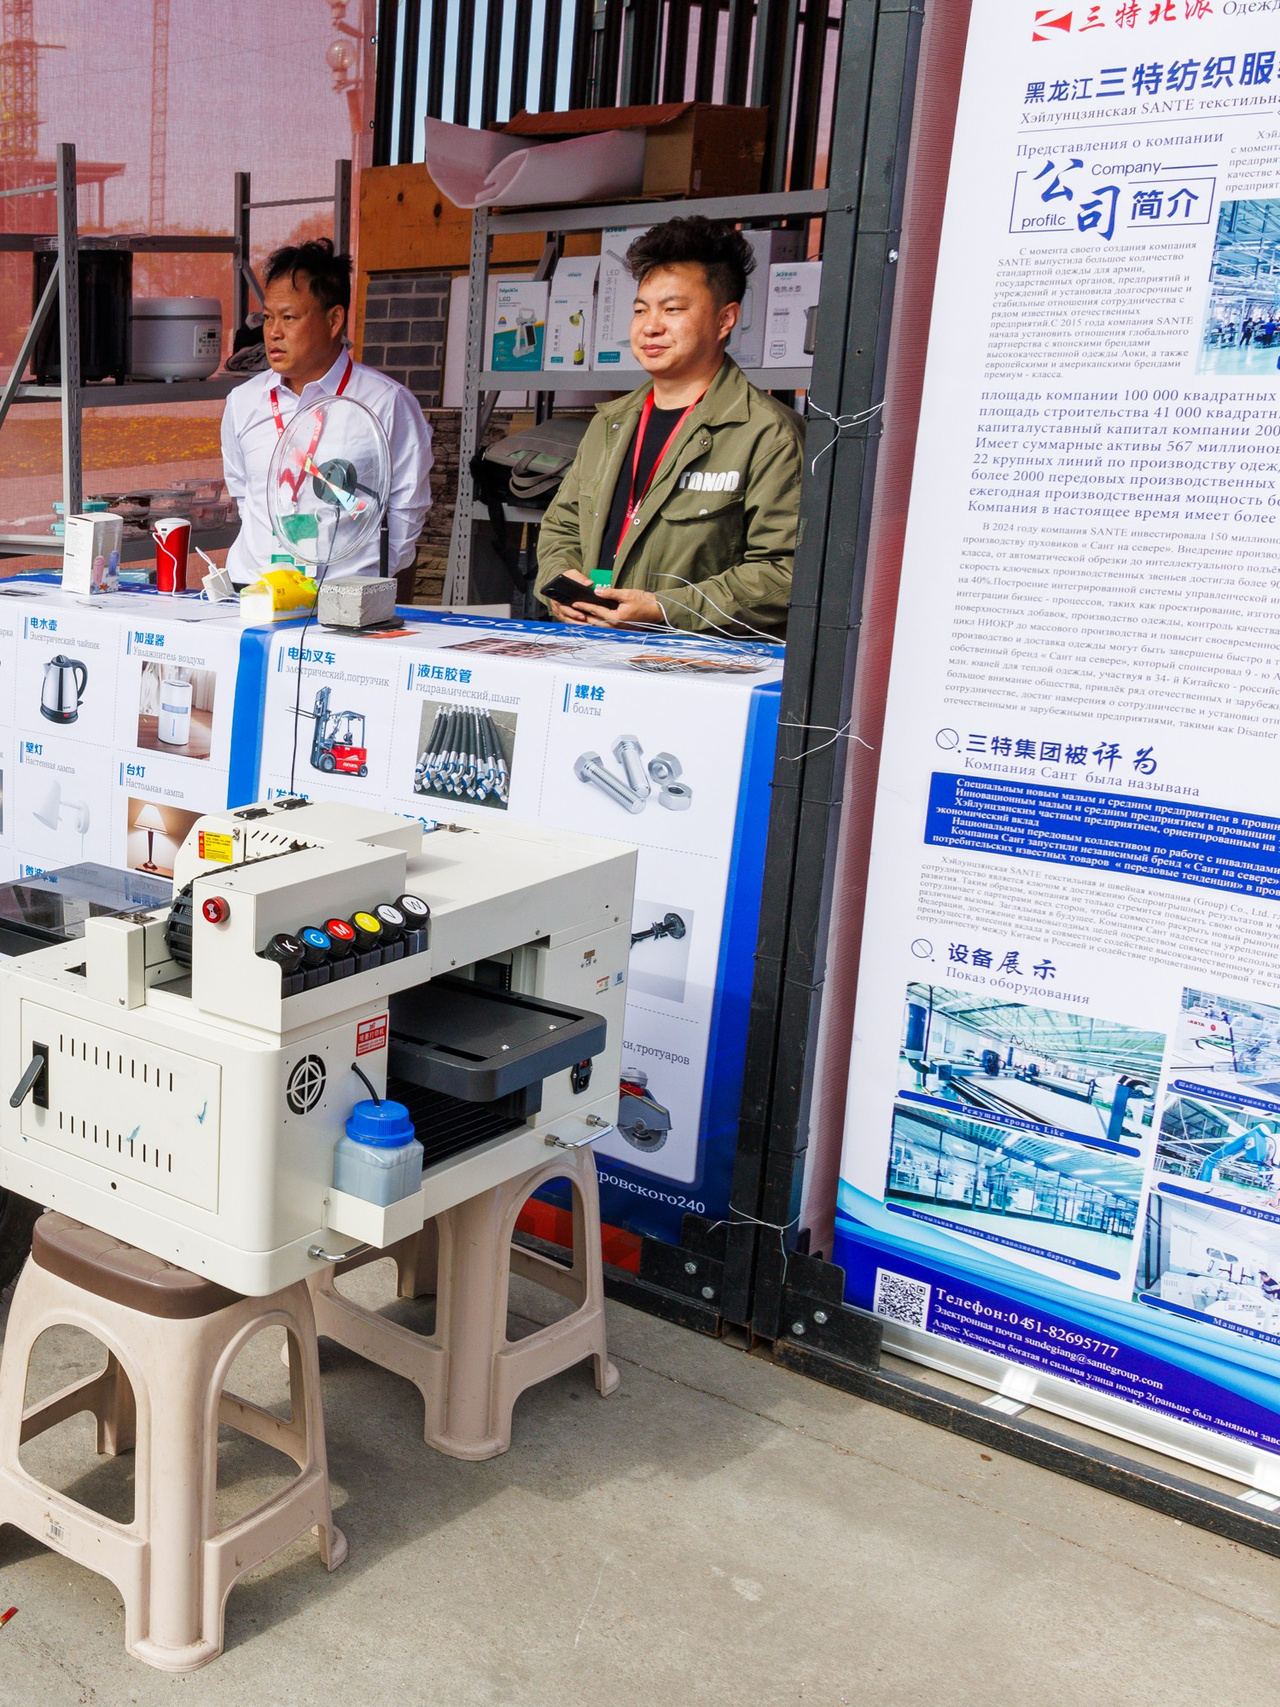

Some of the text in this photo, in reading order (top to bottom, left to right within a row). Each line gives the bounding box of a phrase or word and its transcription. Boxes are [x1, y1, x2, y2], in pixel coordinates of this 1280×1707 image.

[1078, 0, 1214, 32] 三特北派
[1023, 50, 1280, 104] 黑龙江三特纺织服
[1020, 106, 1136, 125] Хэйлунцзянская
[1141, 98, 1194, 114] SANTE
[1016, 133, 1223, 159] Представления о компании
[1091, 162, 1163, 178] Company
[997, 254, 1184, 267] SANTE выпустила большое количество
[981, 389, 1276, 404] площадь компании 100 000 квадратных
[979, 406, 1280, 422] площадь строительства 41 000 квадратн
[977, 423, 1102, 436] капиталуставный
[1106, 425, 1167, 435] капитал
[1172, 426, 1250, 436] компании
[975, 437, 1018, 449] Имеет
[1022, 440, 1103, 453] суммарные
[1106, 442, 1162, 451] активы
[1166, 440, 1193, 452] 567
[973, 453, 1280, 473] 22 крупных линий по производству одеж
[971, 468, 1275, 489] более 2000 передовых производственных
[969, 487, 1040, 498] ежегодная
[1044, 490, 1181, 502] производственная
[1185, 494, 1263, 505] мощность
[967, 500, 1276, 524] Компания в настоящее время имеет более
[30, 616, 57, 631] 电水壶
[29, 630, 100, 650] Электрический чайник
[134, 631, 165, 647] 加湿器
[133, 645, 205, 666] Увлажнитель воздуха
[287, 645, 336, 665] 电动叉车
[417, 663, 472, 684] 液压胶管
[574, 684, 605, 701] 螺栓
[572, 701, 602, 717] болты
[25, 741, 43, 756] 壁灯
[25, 754, 75, 774] Настенная лампа
[126, 763, 145, 778] 台灯
[964, 756, 1199, 797] Компания Сант была называна
[125, 777, 184, 799] Настольная лампа
[936, 806, 1039, 827] экономический вклад
[332, 924, 350, 935] M
[359, 916, 375, 927] Y
[282, 939, 299, 953] K
[310, 933, 324, 944] C
[946, 966, 1089, 1004] Показ оборудования
[622, 1040, 690, 1066] ки,тротуаров
[596, 1170, 706, 1214] ровского240
[934, 1303, 994, 1331] Электронная
[994, 1326, 1023, 1342] почта
[932, 1319, 960, 1334] Адрес:
[1006, 1344, 1040, 1362] богатая
[1049, 1360, 1085, 1377] сильная
[1085, 1372, 1114, 1387] улица
[1115, 1383, 1145, 1399] номер
[1192, 1408, 1212, 1421] был
[1213, 1417, 1258, 1438] льняным
